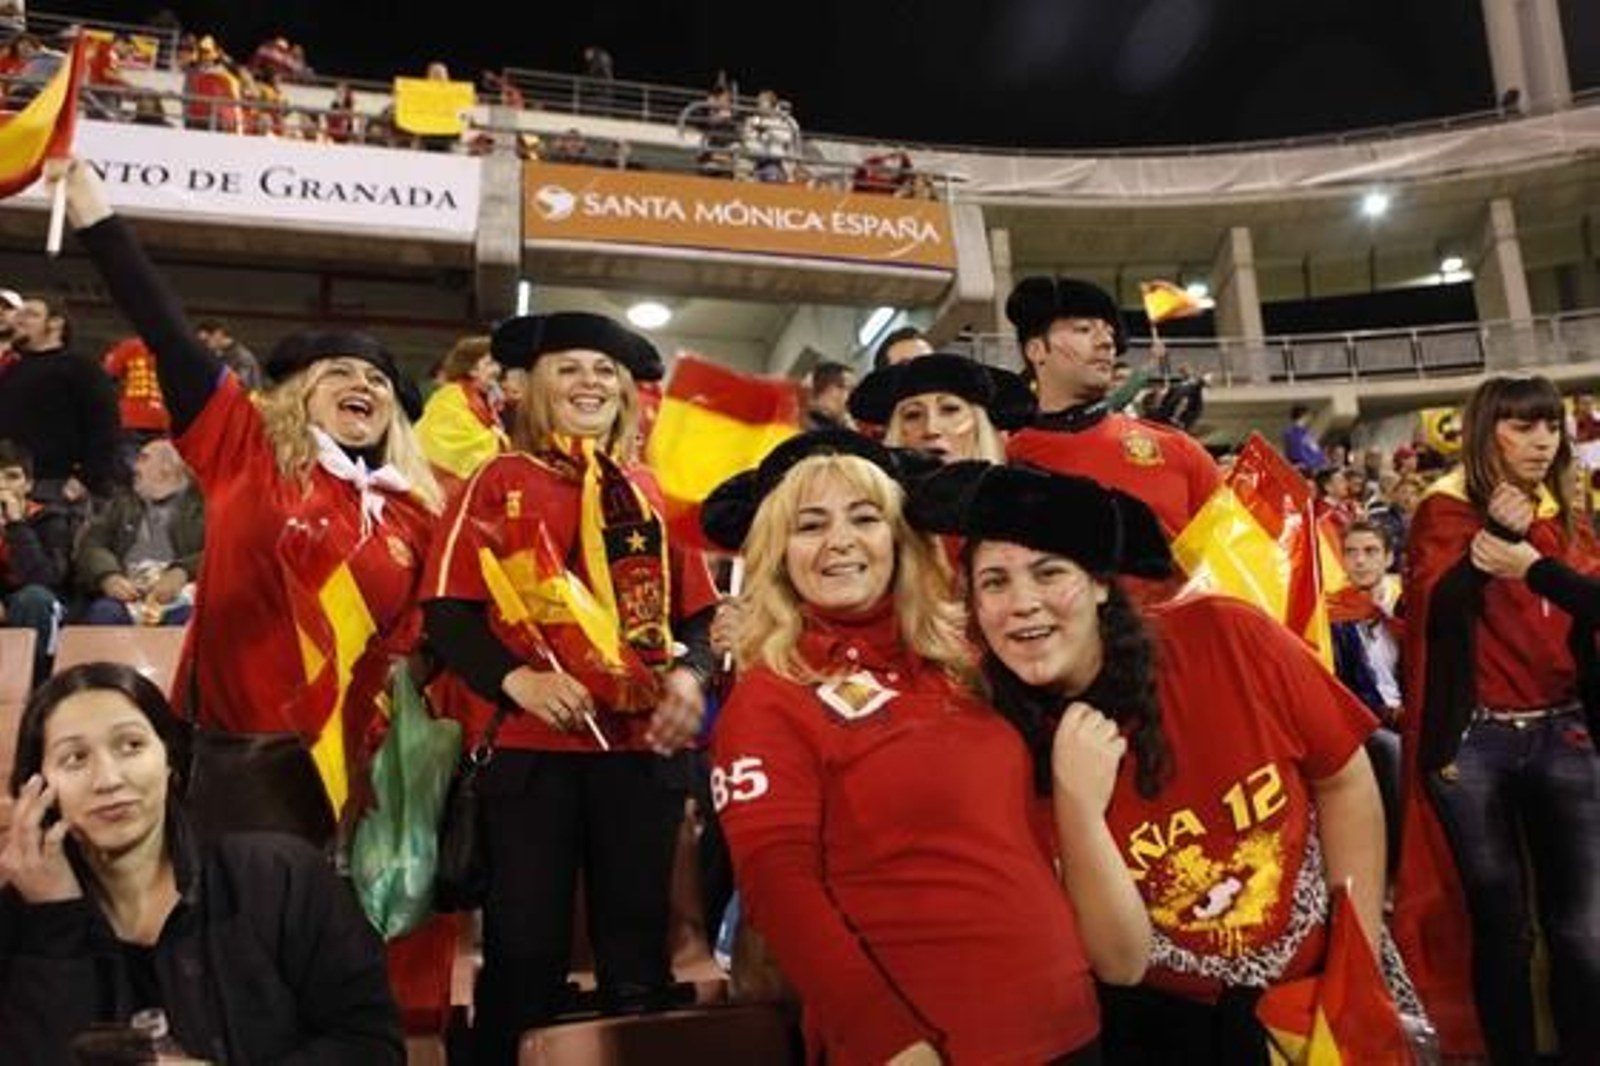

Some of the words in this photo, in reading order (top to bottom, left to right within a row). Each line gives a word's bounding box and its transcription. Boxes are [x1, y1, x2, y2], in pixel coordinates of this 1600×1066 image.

[188, 168, 243, 194] DE
[259, 165, 457, 210] GRANADA
[584, 192, 686, 221] SANTA
[694, 198, 825, 232] MÓNICA
[831, 210, 941, 243] ESPAÑA
[710, 756, 769, 813] 85
[1128, 808, 1208, 880] ÑA
[1221, 762, 1289, 832] 12
